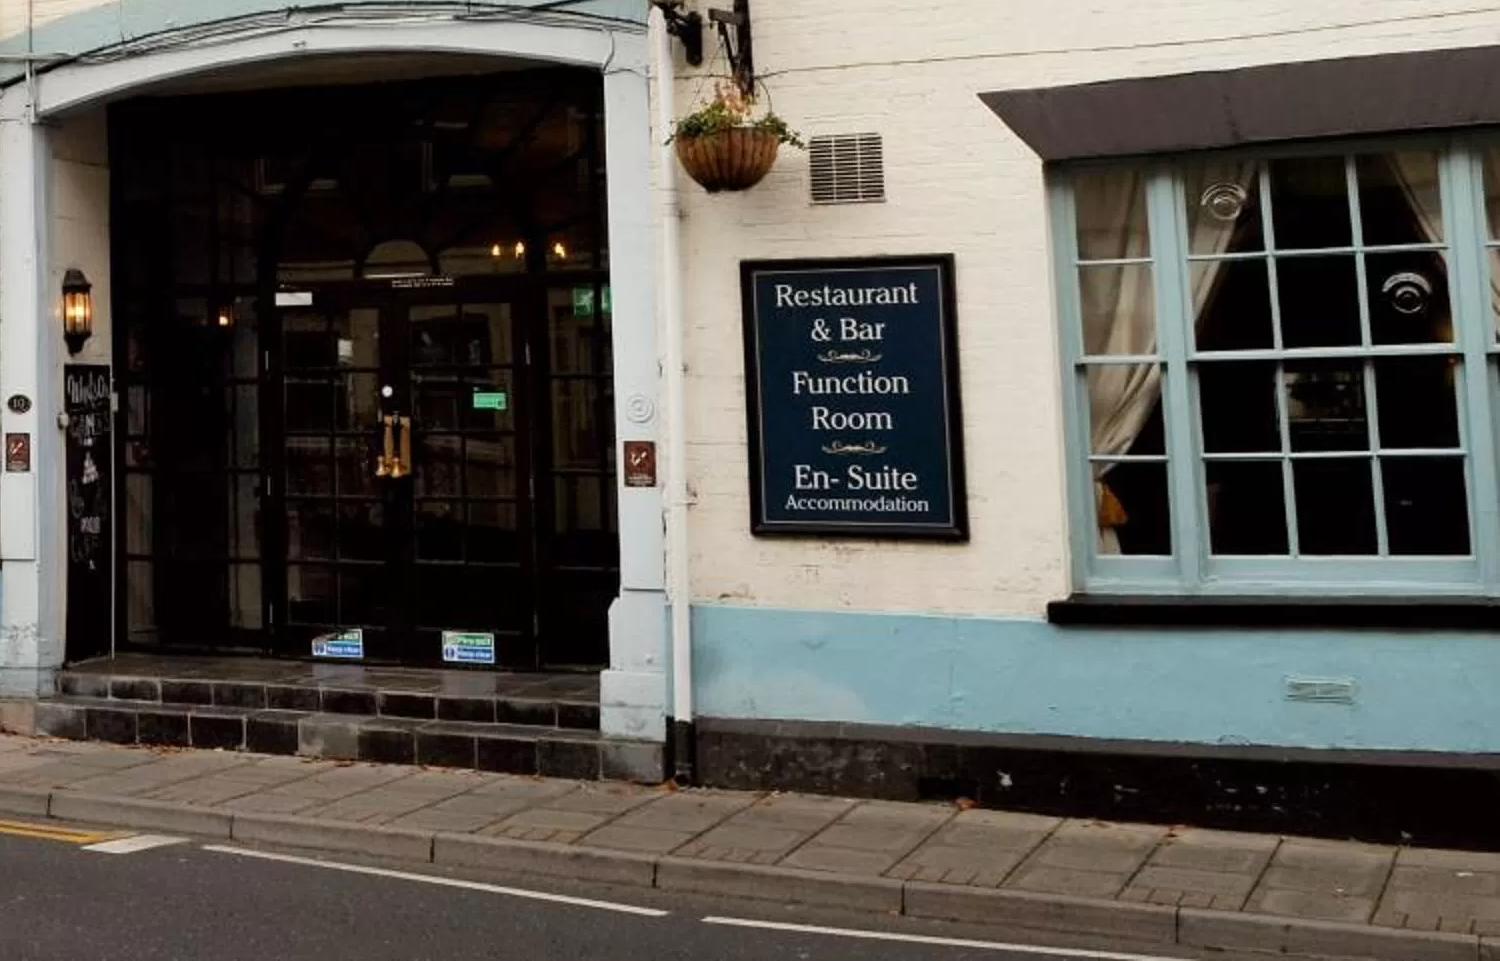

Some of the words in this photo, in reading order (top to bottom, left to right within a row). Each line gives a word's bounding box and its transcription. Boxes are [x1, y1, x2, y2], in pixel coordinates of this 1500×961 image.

[775, 282, 919, 308] Restaurant
[811, 318, 831, 341] &
[840, 318, 886, 341] Bar
[792, 371, 909, 395] Function
[812, 406, 893, 430] Room
[795, 464, 839, 490] En-
[848, 465, 918, 490] Suite
[785, 494, 930, 513] Accommodation
